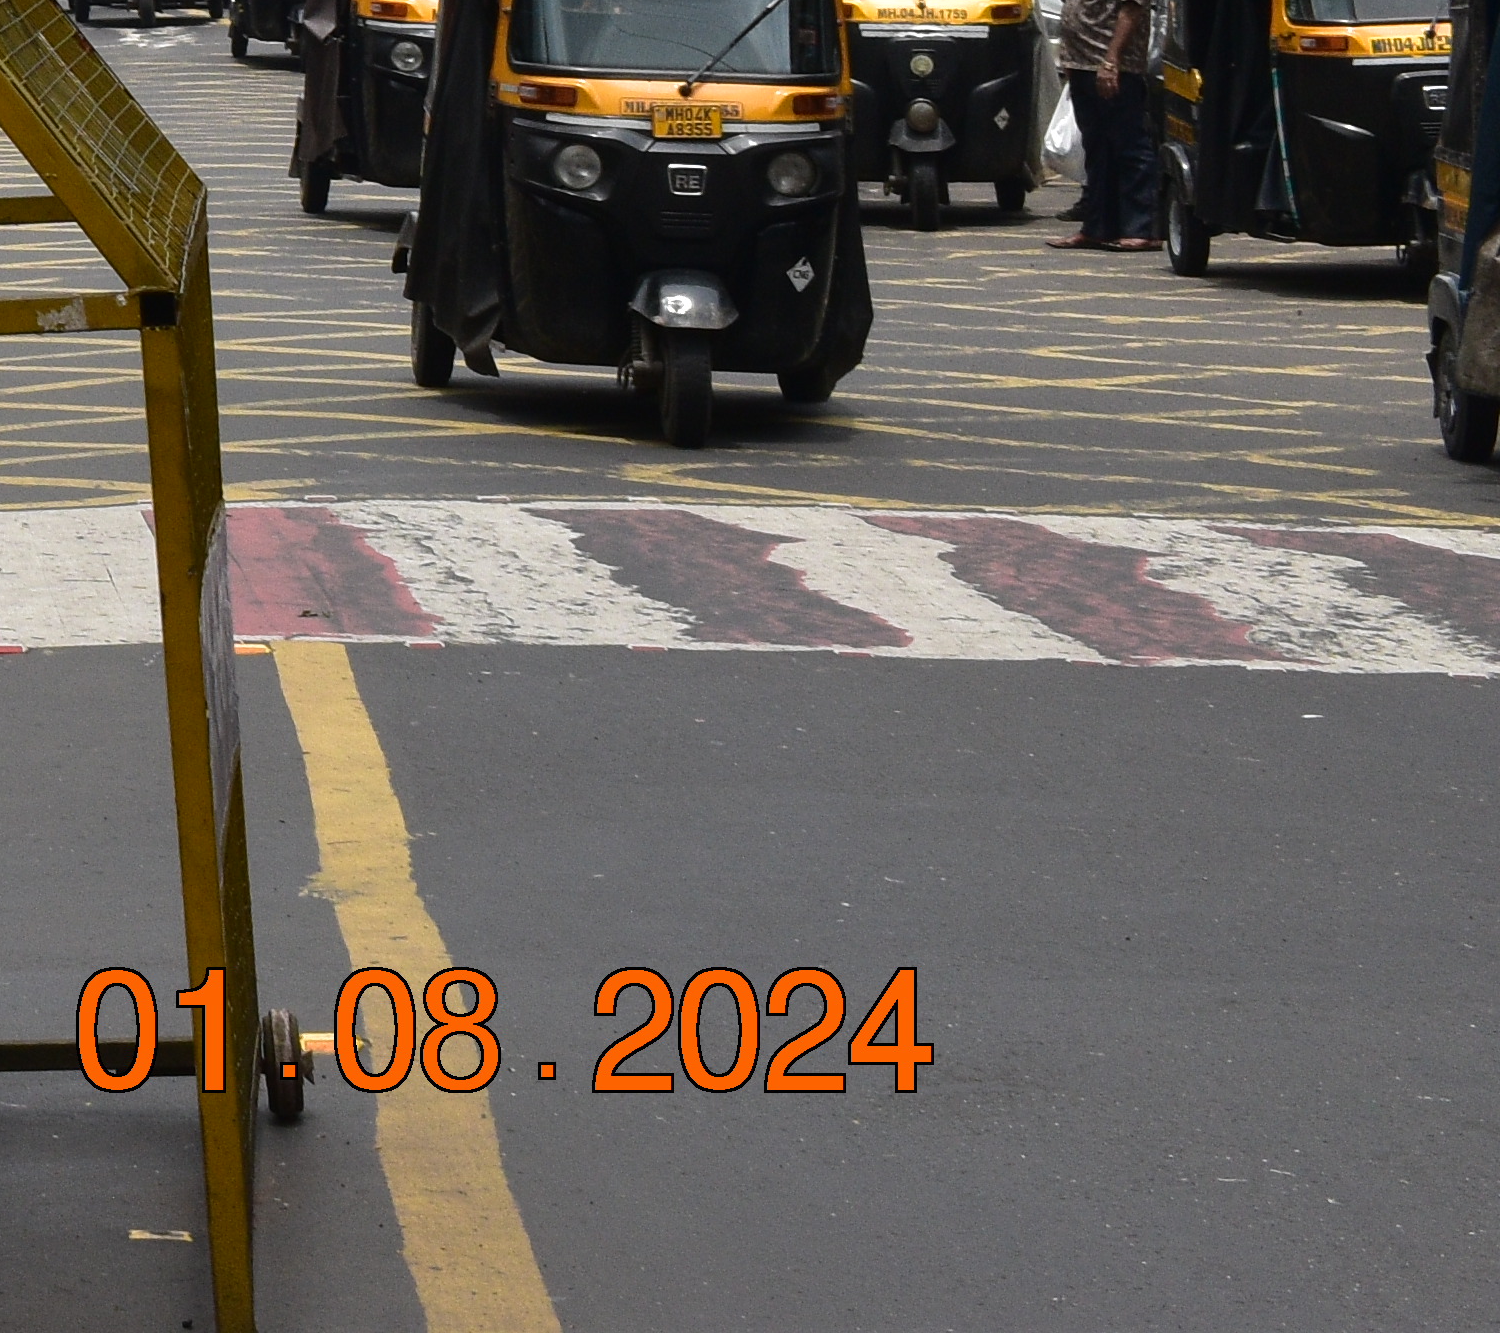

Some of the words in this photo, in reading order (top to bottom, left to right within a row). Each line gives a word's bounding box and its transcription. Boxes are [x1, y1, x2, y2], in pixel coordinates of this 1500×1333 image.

[665, 107, 712, 121] MH04K
[667, 122, 713, 137] A8355
[675, 174, 701, 189] RE
